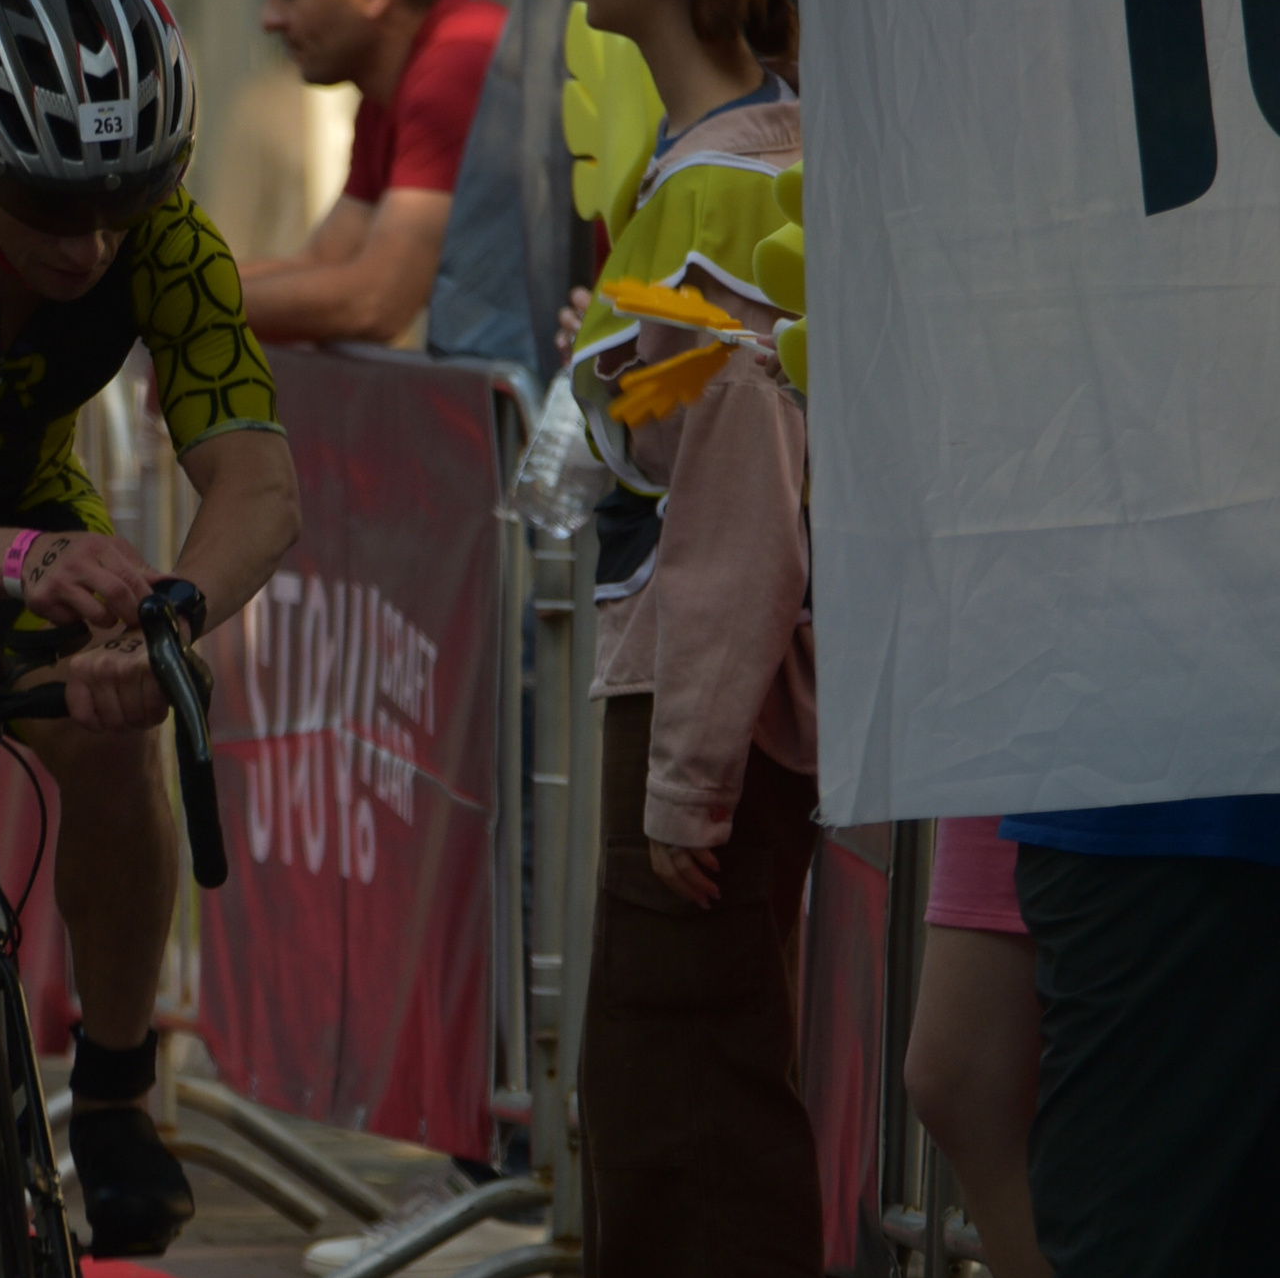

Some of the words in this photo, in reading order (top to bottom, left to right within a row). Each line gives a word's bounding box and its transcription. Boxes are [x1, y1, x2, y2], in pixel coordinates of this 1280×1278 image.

[94, 116, 123, 135] 263
[29, 538, 70, 583] 263
[380, 599, 439, 738] CRAFT
